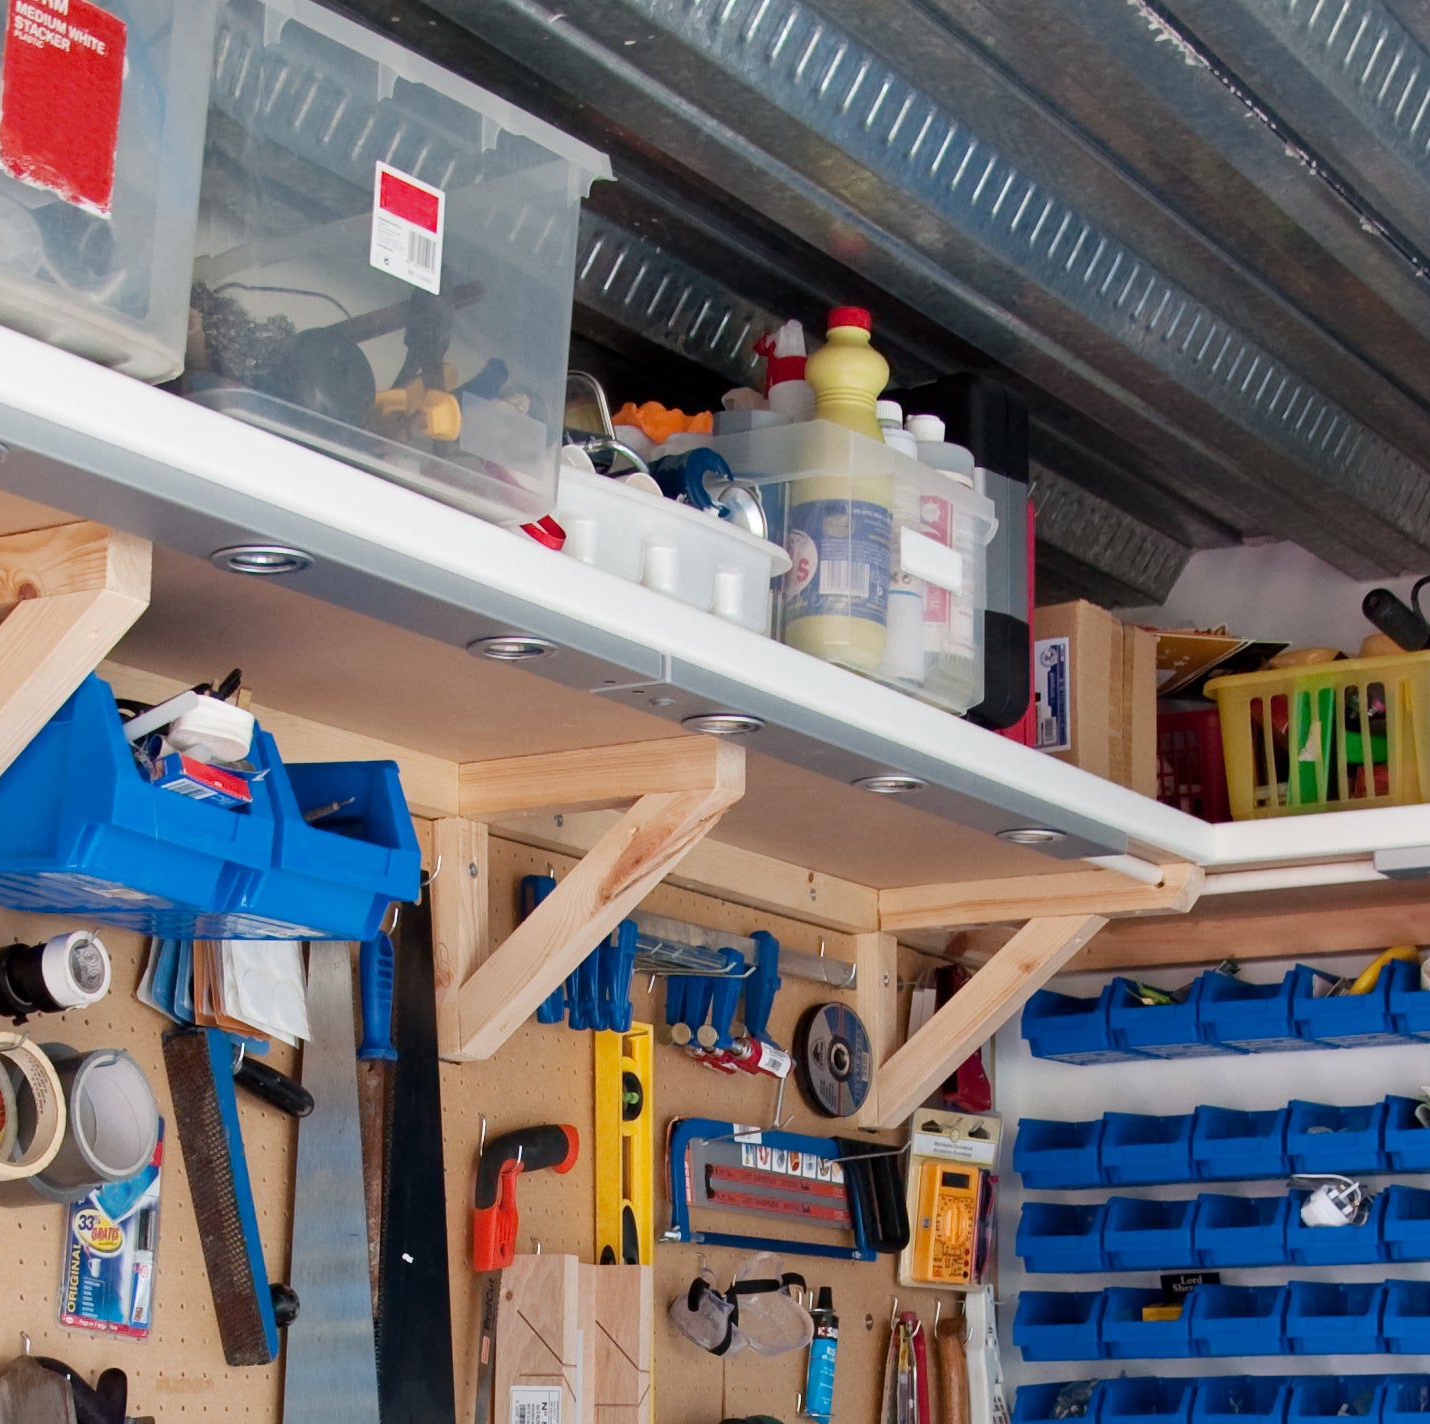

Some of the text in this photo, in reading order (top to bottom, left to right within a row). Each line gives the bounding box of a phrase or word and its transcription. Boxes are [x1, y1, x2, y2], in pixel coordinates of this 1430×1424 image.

[14, 16, 70, 52] STACKER
[15, 1, 106, 56] MEDIUM WHITE
[91, 1226, 120, 1242] GRATIS
[67, 1242, 82, 1313] ORIGINAL
[1181, 1275, 1203, 1285] Lord
